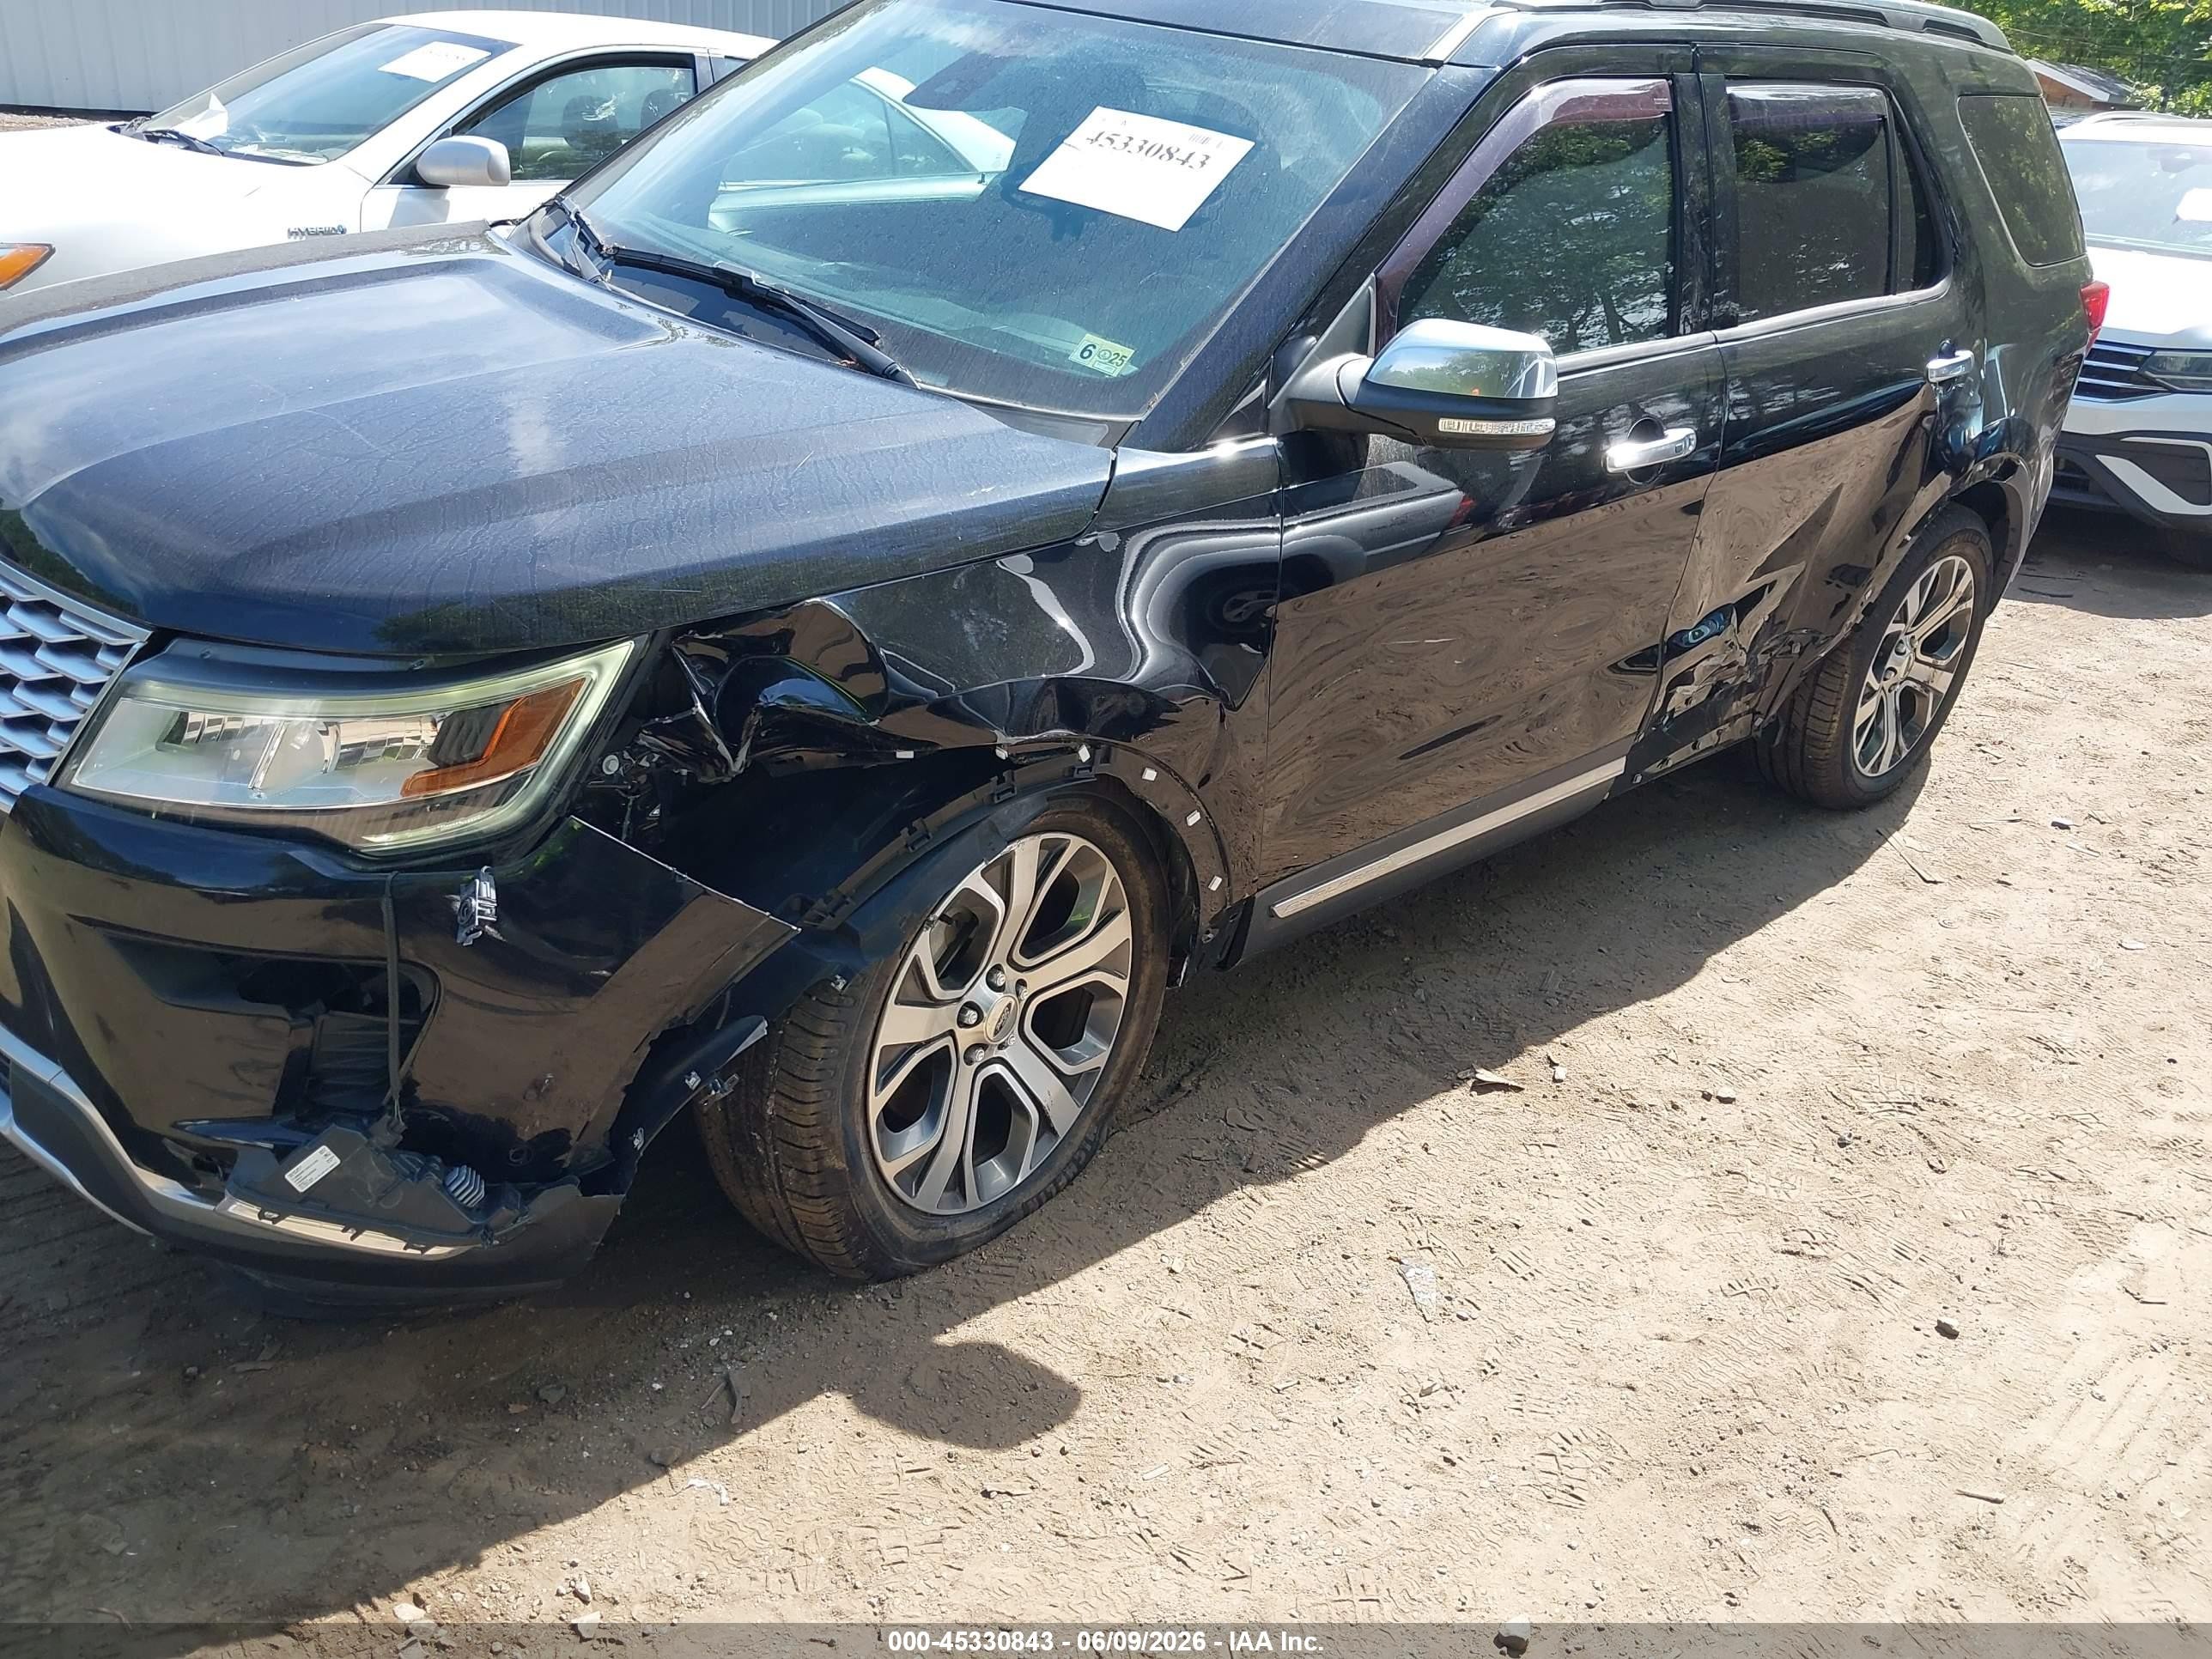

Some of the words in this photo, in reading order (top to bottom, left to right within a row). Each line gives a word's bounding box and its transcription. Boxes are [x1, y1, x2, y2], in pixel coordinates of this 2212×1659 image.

[1085, 130, 1212, 170] 45330843
[1079, 343, 1097, 360] 6
[1108, 352, 1127, 368] 25
